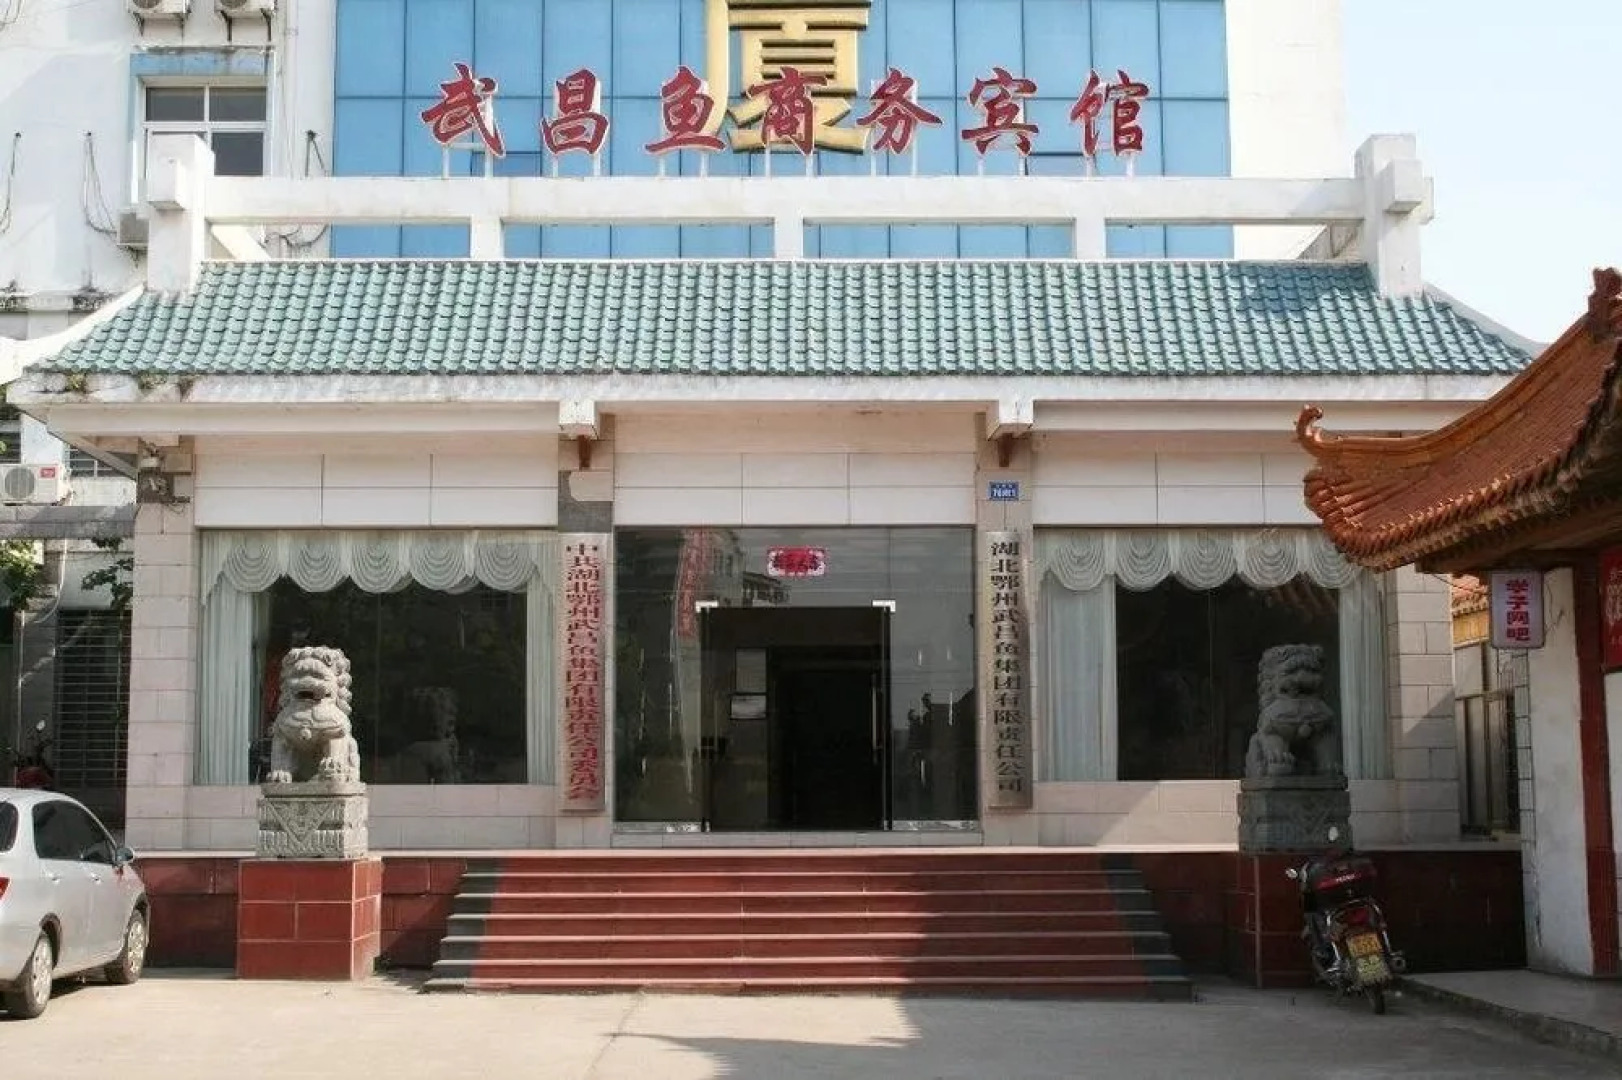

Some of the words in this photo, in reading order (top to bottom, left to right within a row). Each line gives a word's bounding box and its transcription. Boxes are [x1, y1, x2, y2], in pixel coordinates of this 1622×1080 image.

[420, 62, 1151, 158] 武昌鱼商务宾馆
[1505, 578, 1531, 642] 学子网吧
[990, 541, 1024, 794] 湖北鄂州武昌鱼集团有限责任公司
